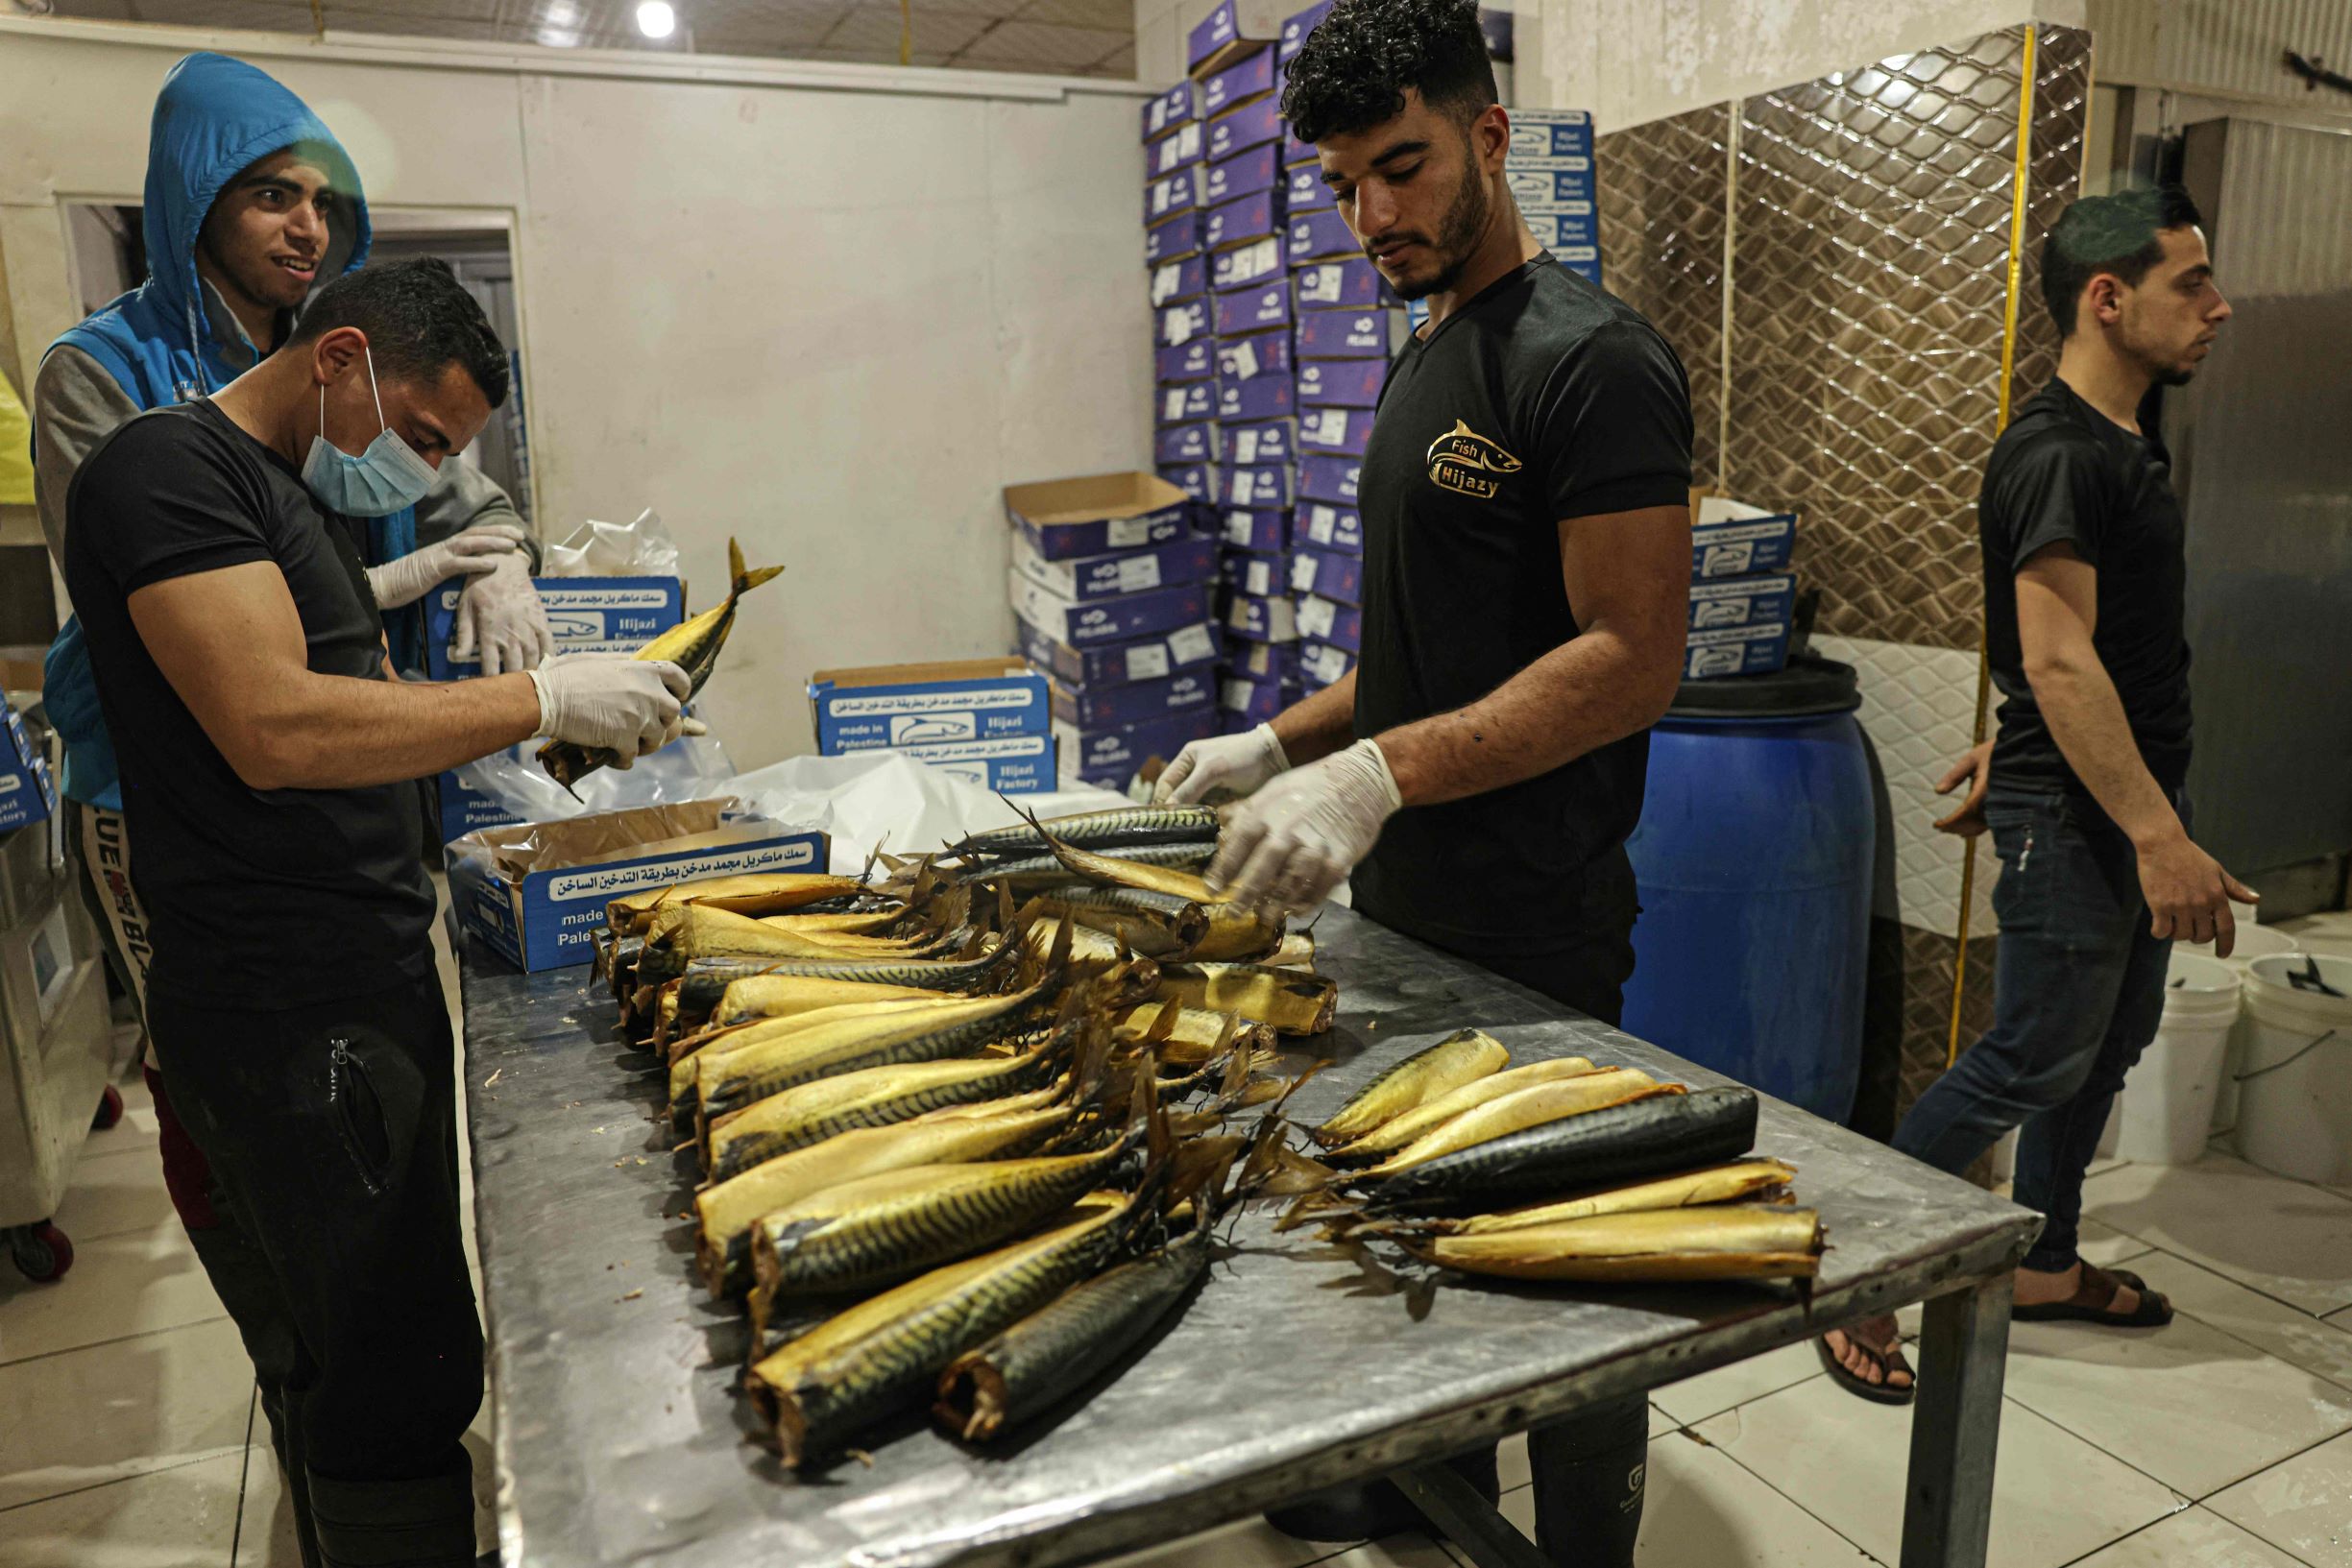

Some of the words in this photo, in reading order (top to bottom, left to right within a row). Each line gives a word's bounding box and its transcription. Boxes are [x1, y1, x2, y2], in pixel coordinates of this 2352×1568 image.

[1451, 439, 1478, 458] Fish
[1442, 466, 1500, 496] Hijazy
[618, 618, 657, 633] Hijazi
[838, 725, 870, 736] made
[872, 724, 884, 734] in
[987, 715, 1023, 730] Hijazi
[837, 738, 887, 749] Palestine
[1001, 764, 1034, 778] Hijazi
[996, 778, 1038, 790] Factory
[741, 850, 783, 869] ماكريل
[784, 848, 808, 860] سمك
[681, 862, 712, 878] مدخن
[713, 859, 741, 872] مجمد
[599, 871, 640, 889] التدخين
[641, 866, 680, 882] بطريقة
[557, 877, 597, 896] الساخن
[562, 909, 604, 926] made
[558, 931, 592, 946] Pale
